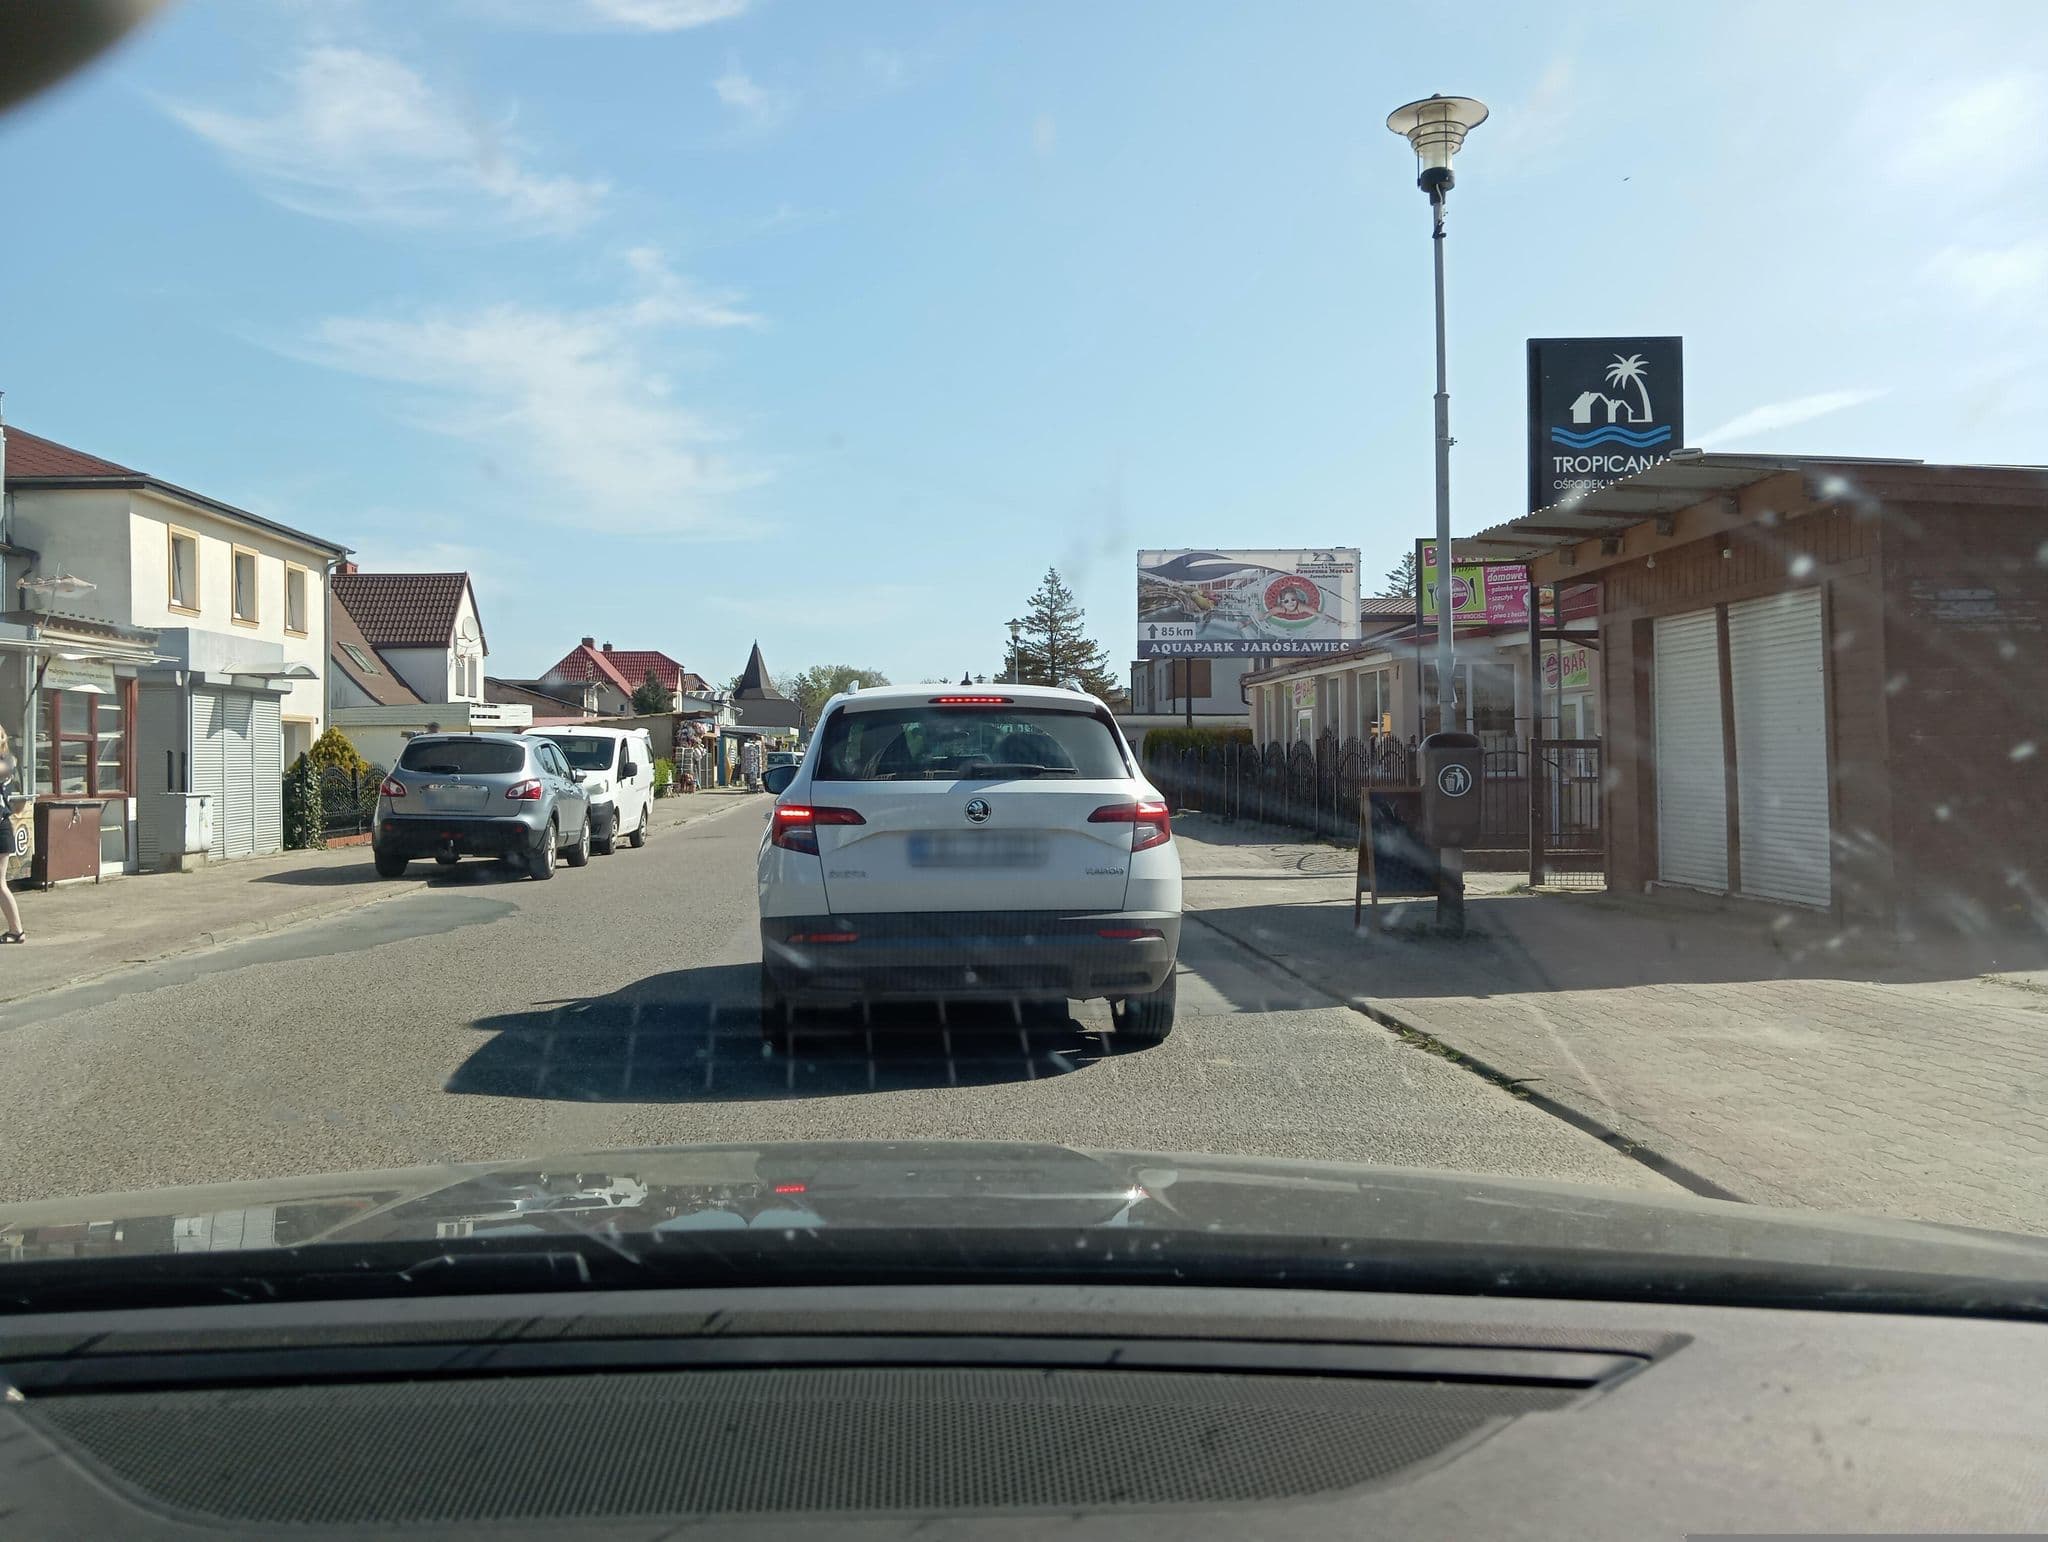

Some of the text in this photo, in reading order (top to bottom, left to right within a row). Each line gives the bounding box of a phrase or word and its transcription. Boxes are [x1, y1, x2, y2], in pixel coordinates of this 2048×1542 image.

[1553, 478, 1603, 489] OŚRODEK
[1487, 572, 1522, 582] domowe
[1161, 625, 1193, 637] 85 km
[1150, 642, 1234, 654] AQUAPARK
[1563, 650, 1586, 676] BAR
